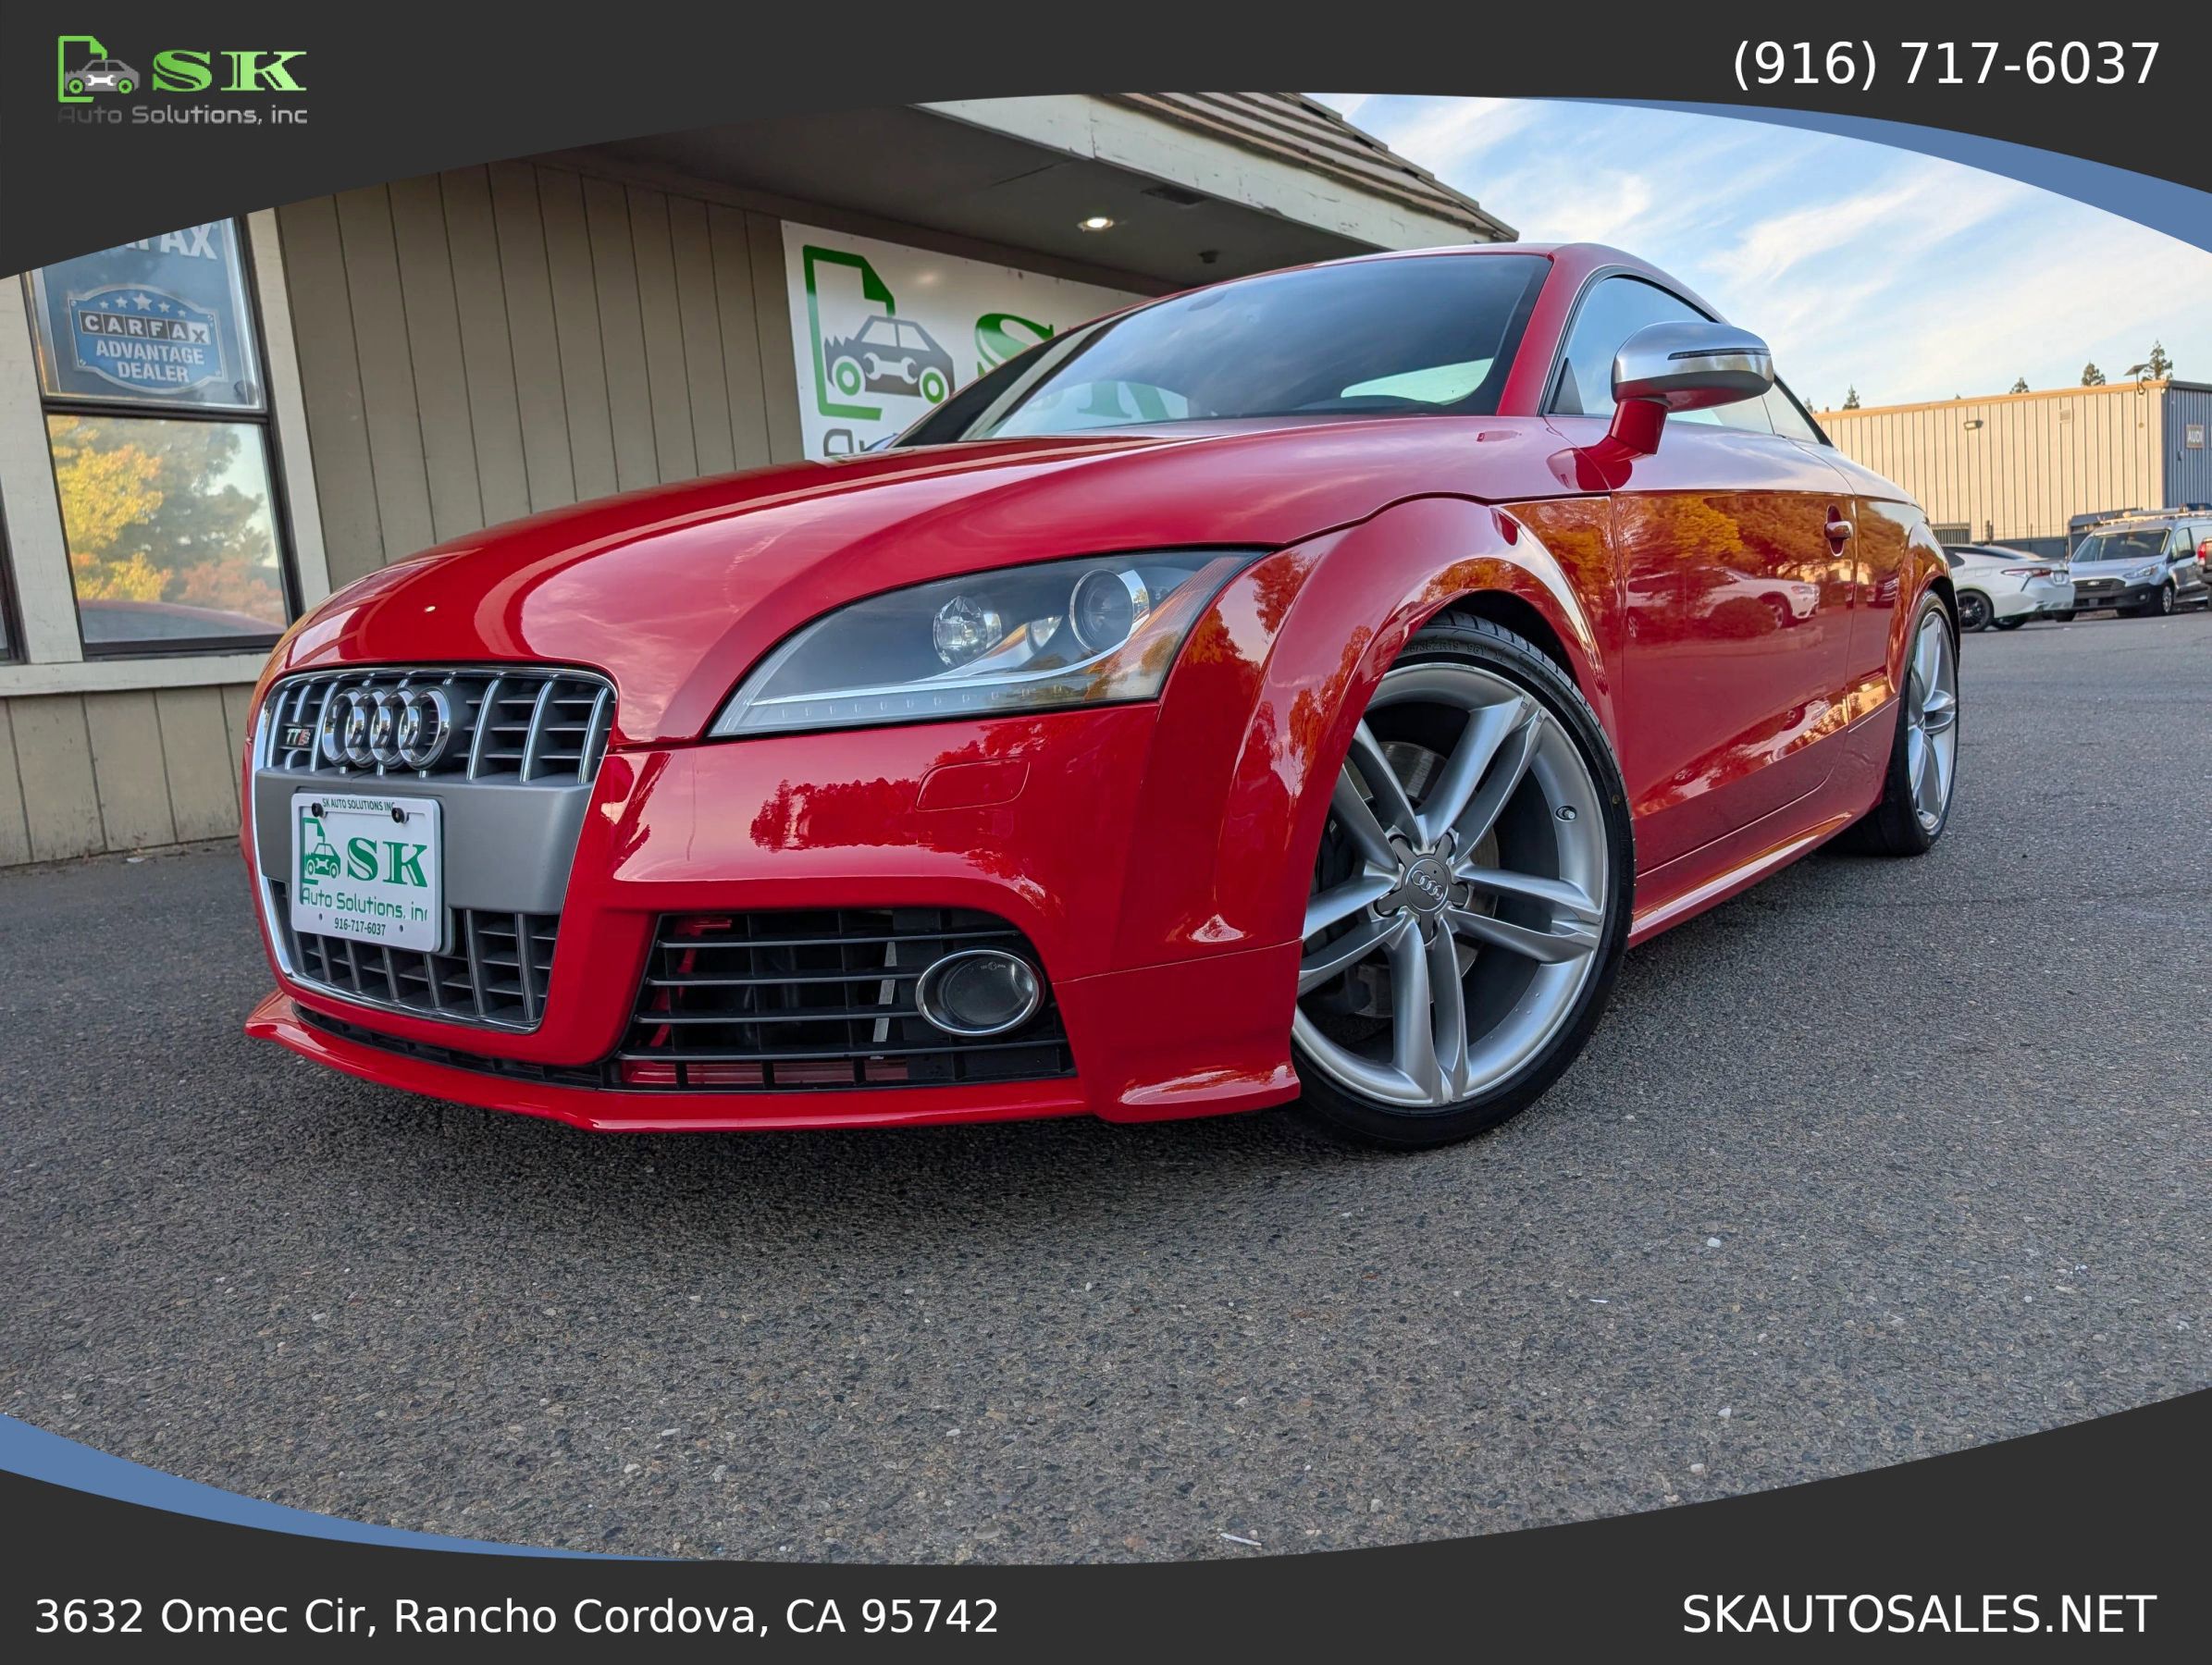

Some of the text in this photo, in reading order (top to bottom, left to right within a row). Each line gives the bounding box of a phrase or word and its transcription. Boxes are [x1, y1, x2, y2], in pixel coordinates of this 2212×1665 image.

[84, 314, 209, 344] CARFAX
[95, 339, 205, 365] ADVANTAGE
[117, 362, 190, 383] DEALER
[322, 797, 331, 808] SK
[331, 798, 347, 809] AUTO
[348, 799, 384, 811] SOLUTIONS
[347, 836, 428, 888] SK
[302, 887, 332, 907] Auto
[334, 917, 387, 937] 916-717-6037
